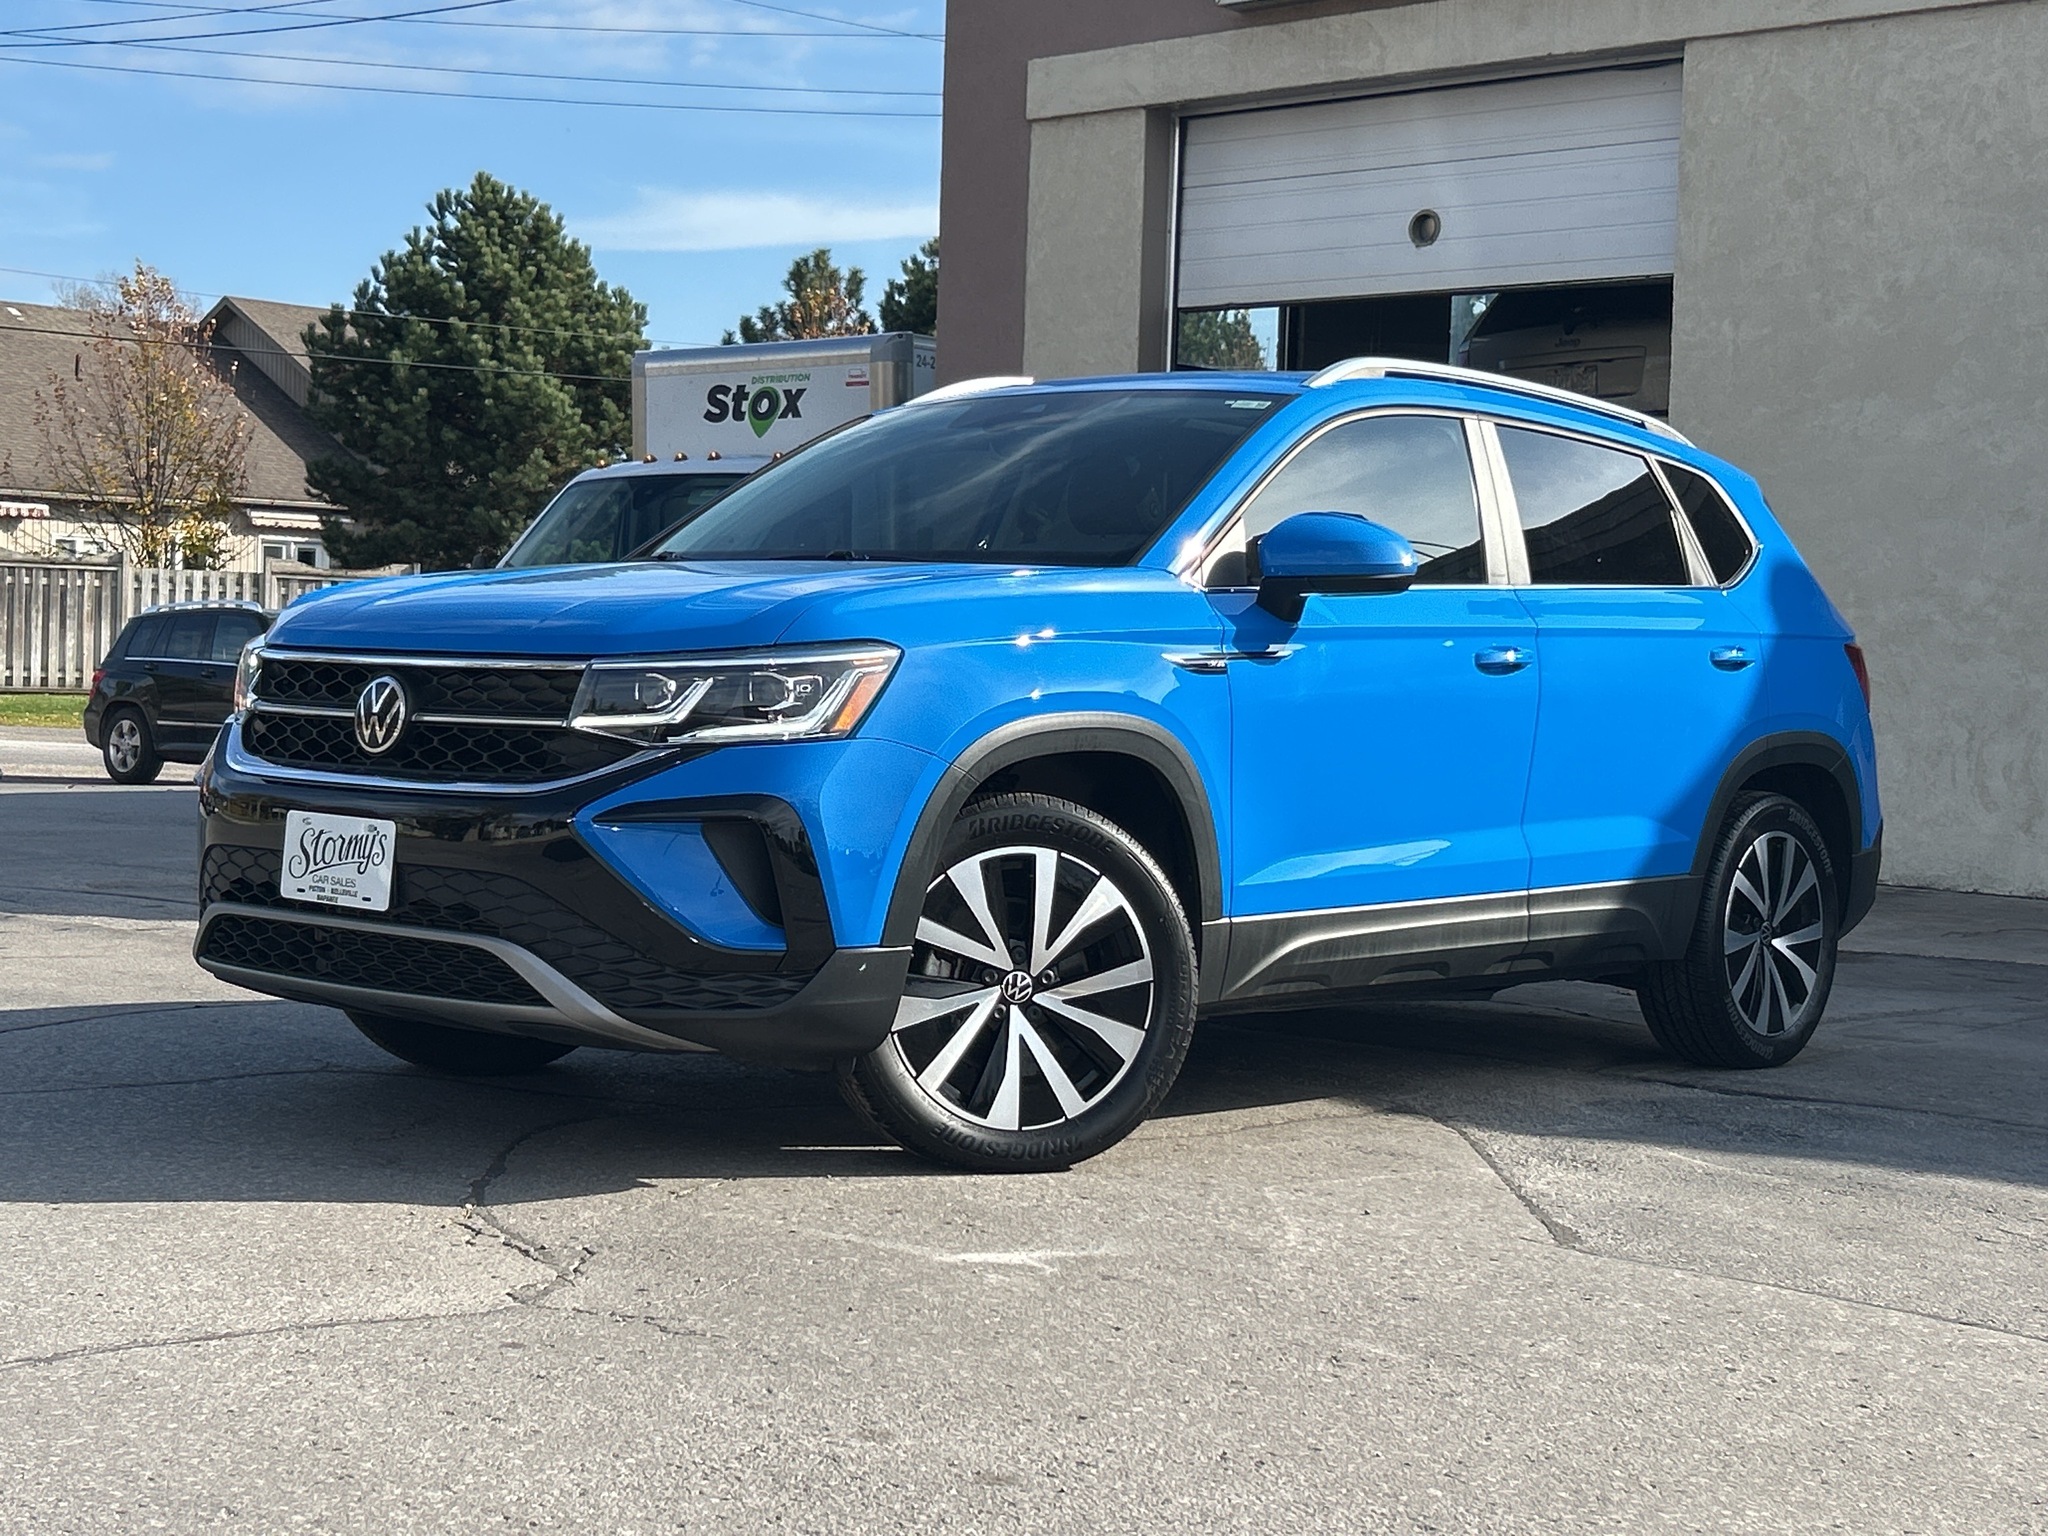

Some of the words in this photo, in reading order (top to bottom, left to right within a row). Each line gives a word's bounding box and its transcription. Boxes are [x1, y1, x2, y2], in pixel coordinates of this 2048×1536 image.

[751, 373, 811, 385] DISTRIBUTION
[703, 384, 808, 424] Stox
[288, 827, 388, 879] Stormy's
[968, 813, 1117, 853] BRIDGESTONE
[1788, 807, 1834, 877] BRIDGESTONE
[312, 874, 329, 885] CAR
[330, 876, 357, 888] SALES
[929, 1122, 1082, 1161] BRIDGESTONE
